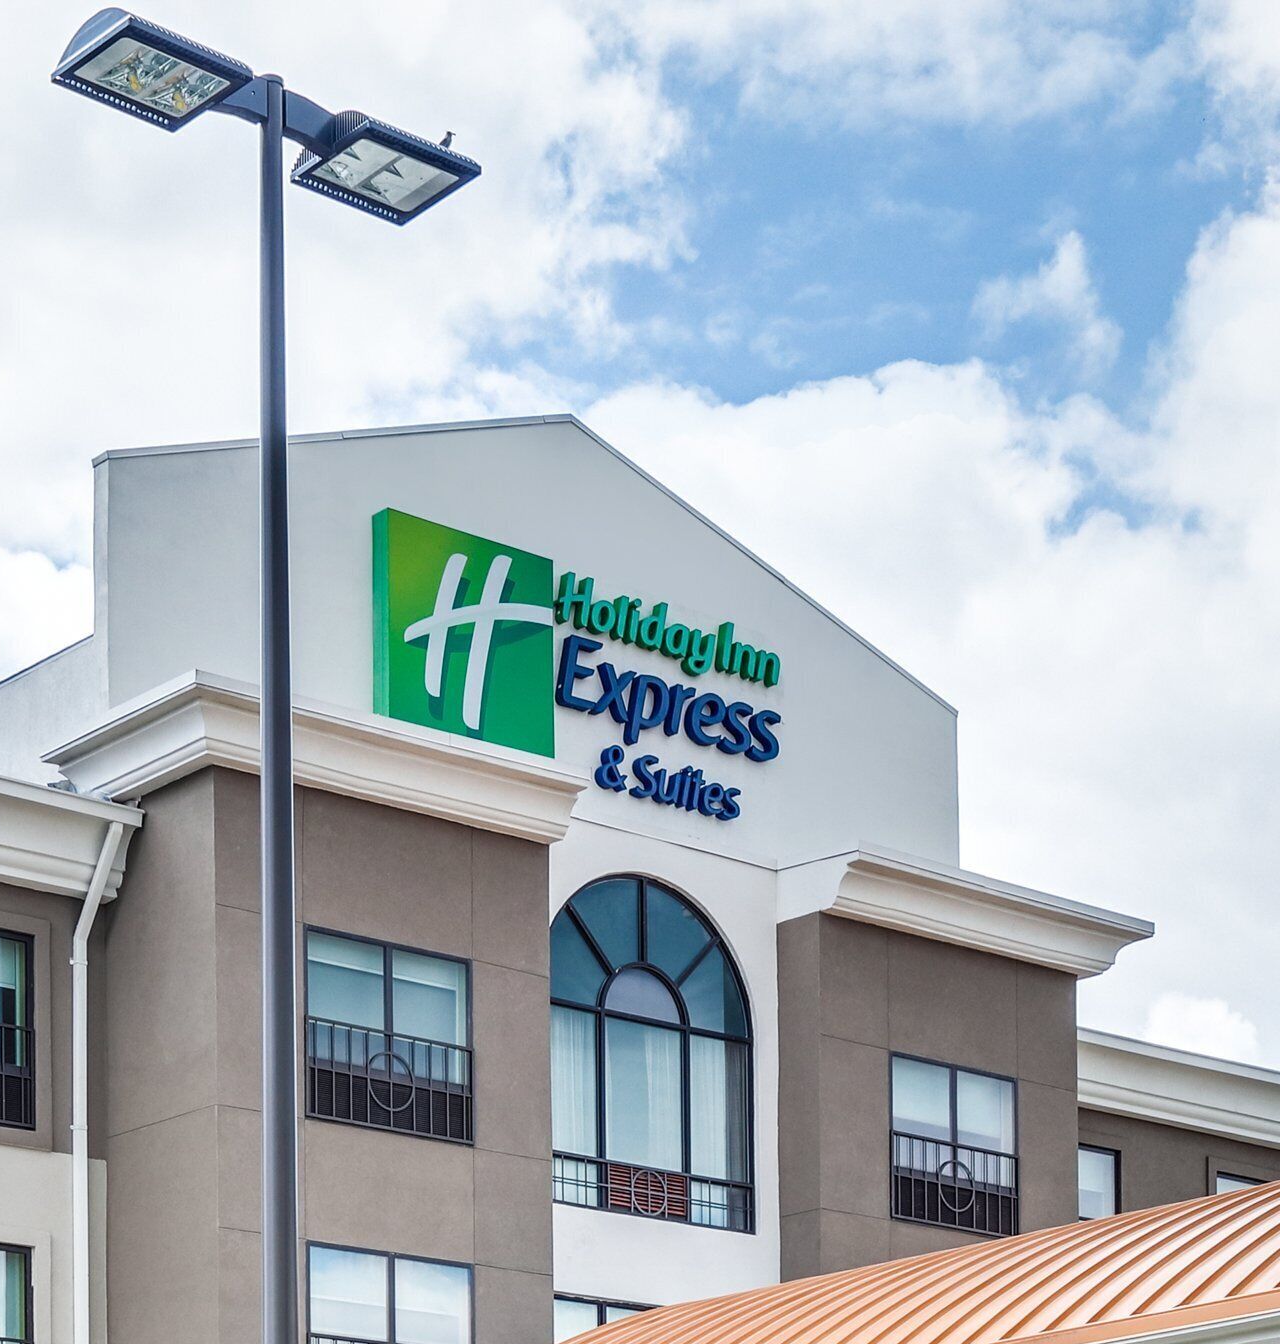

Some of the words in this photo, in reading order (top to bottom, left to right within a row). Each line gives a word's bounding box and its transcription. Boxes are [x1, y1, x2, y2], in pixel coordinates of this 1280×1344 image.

[554, 635, 782, 763] Express
[594, 745, 627, 792] &
[630, 753, 742, 821] Suites
